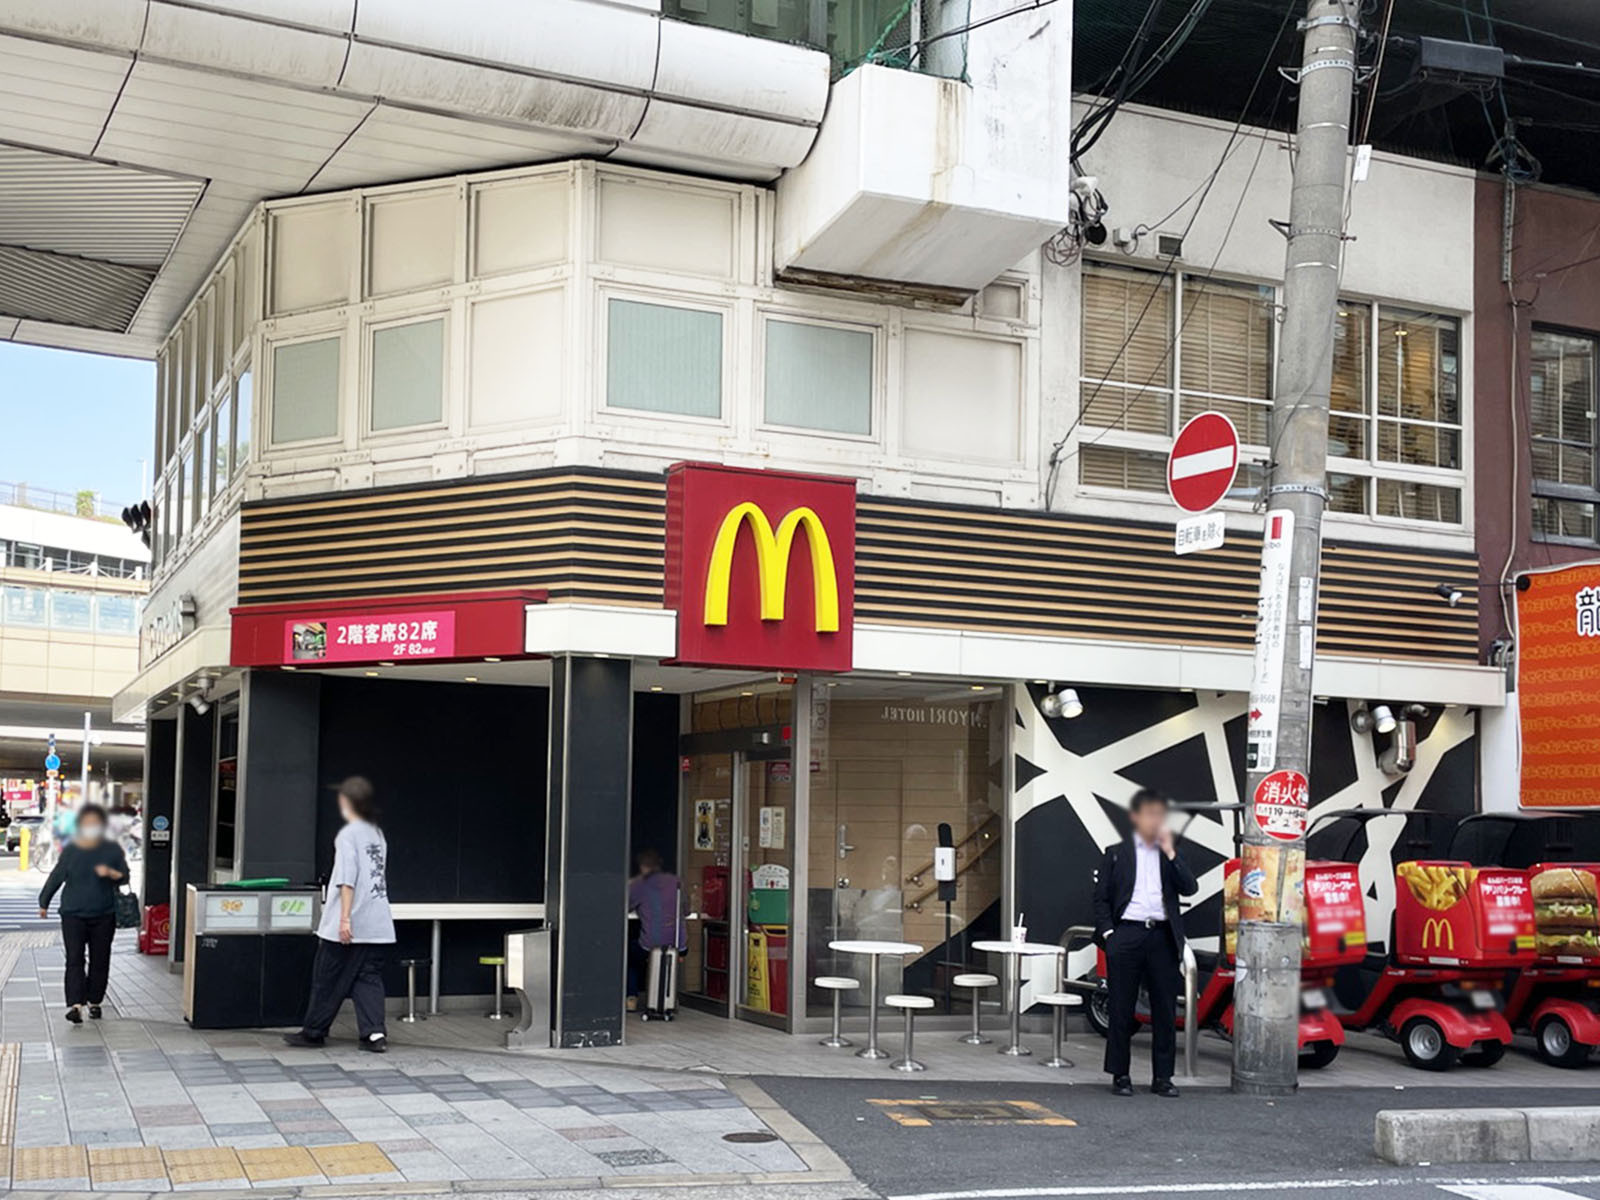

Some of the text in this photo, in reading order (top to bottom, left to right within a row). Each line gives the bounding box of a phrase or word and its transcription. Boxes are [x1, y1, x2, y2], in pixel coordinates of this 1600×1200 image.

[1178, 521, 1221, 546] 自転車を除く
[704, 501, 839, 633] M
[337, 620, 438, 644] 2階客席82席
[393, 643, 406, 655] 2F
